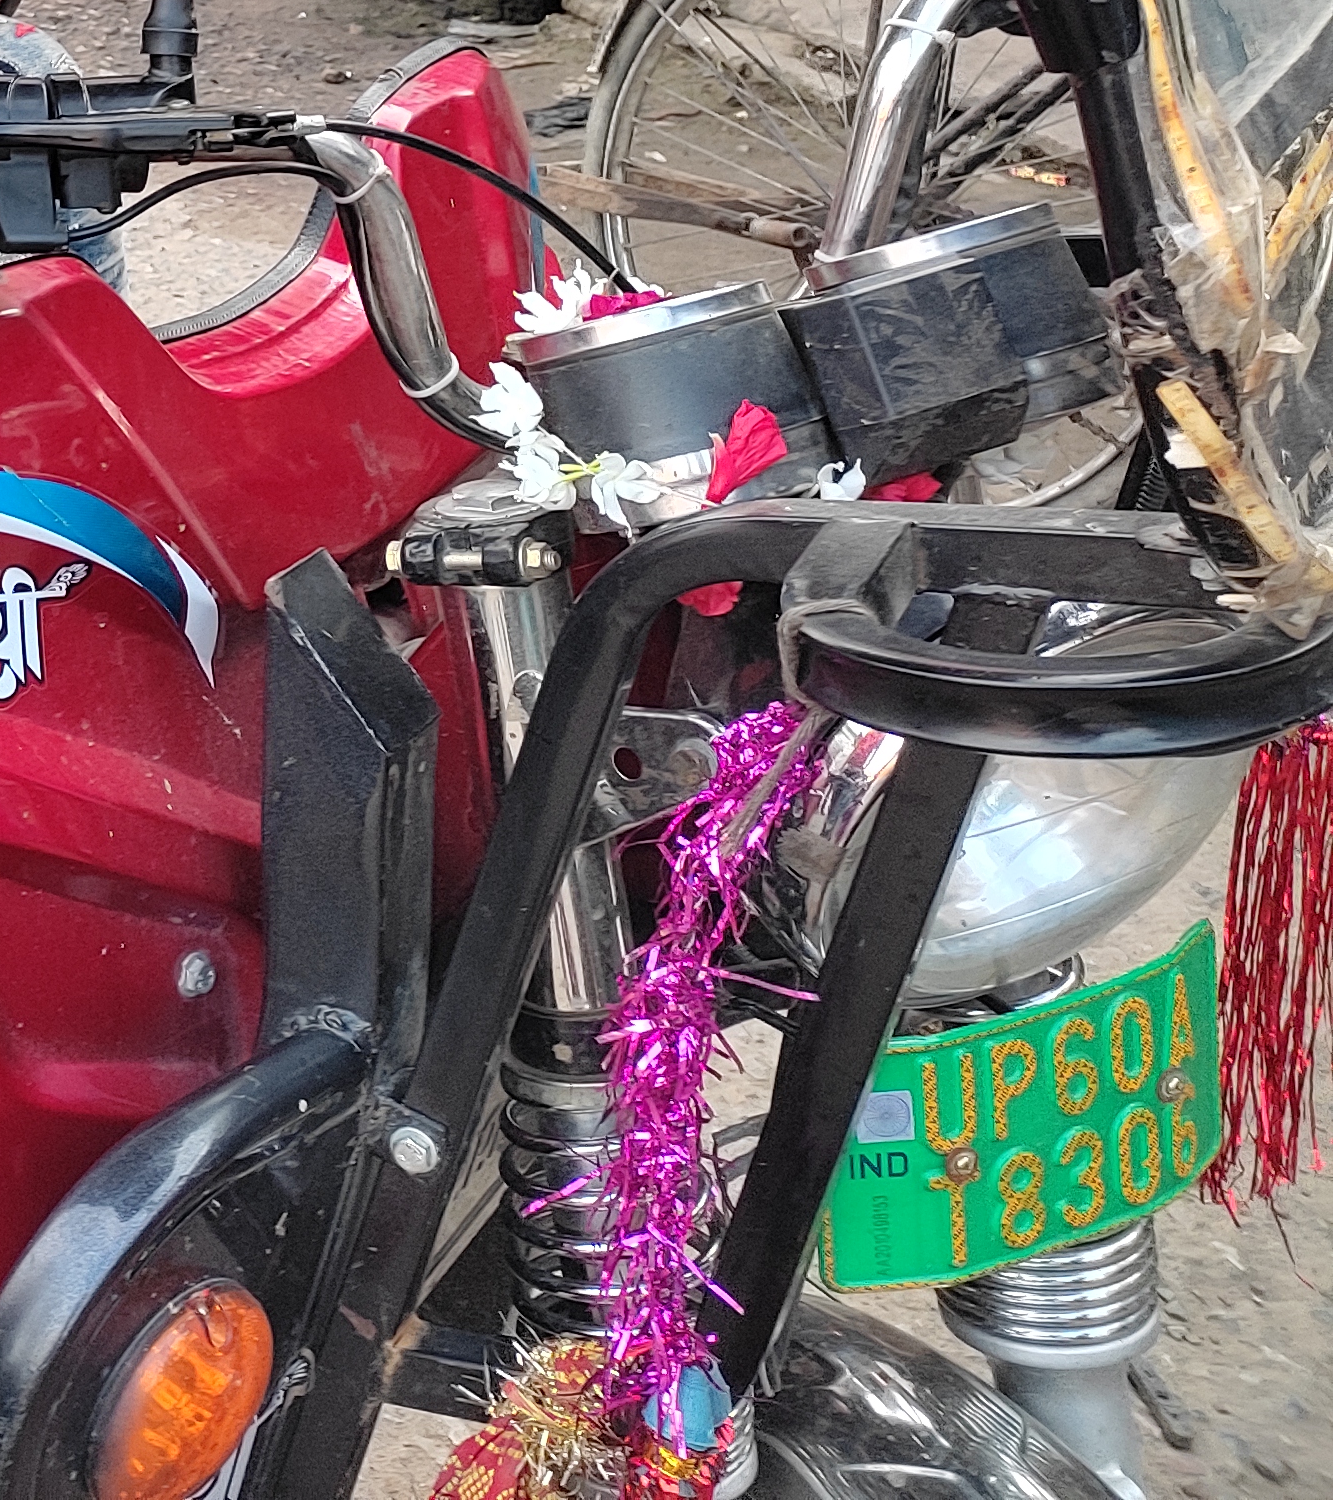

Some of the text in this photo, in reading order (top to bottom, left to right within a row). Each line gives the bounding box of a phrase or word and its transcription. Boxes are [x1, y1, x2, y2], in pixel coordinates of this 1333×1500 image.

[921, 972, 1197, 1156] UP60A
[849, 1151, 909, 1181] IND
[927, 1083, 1198, 1268] T8306
